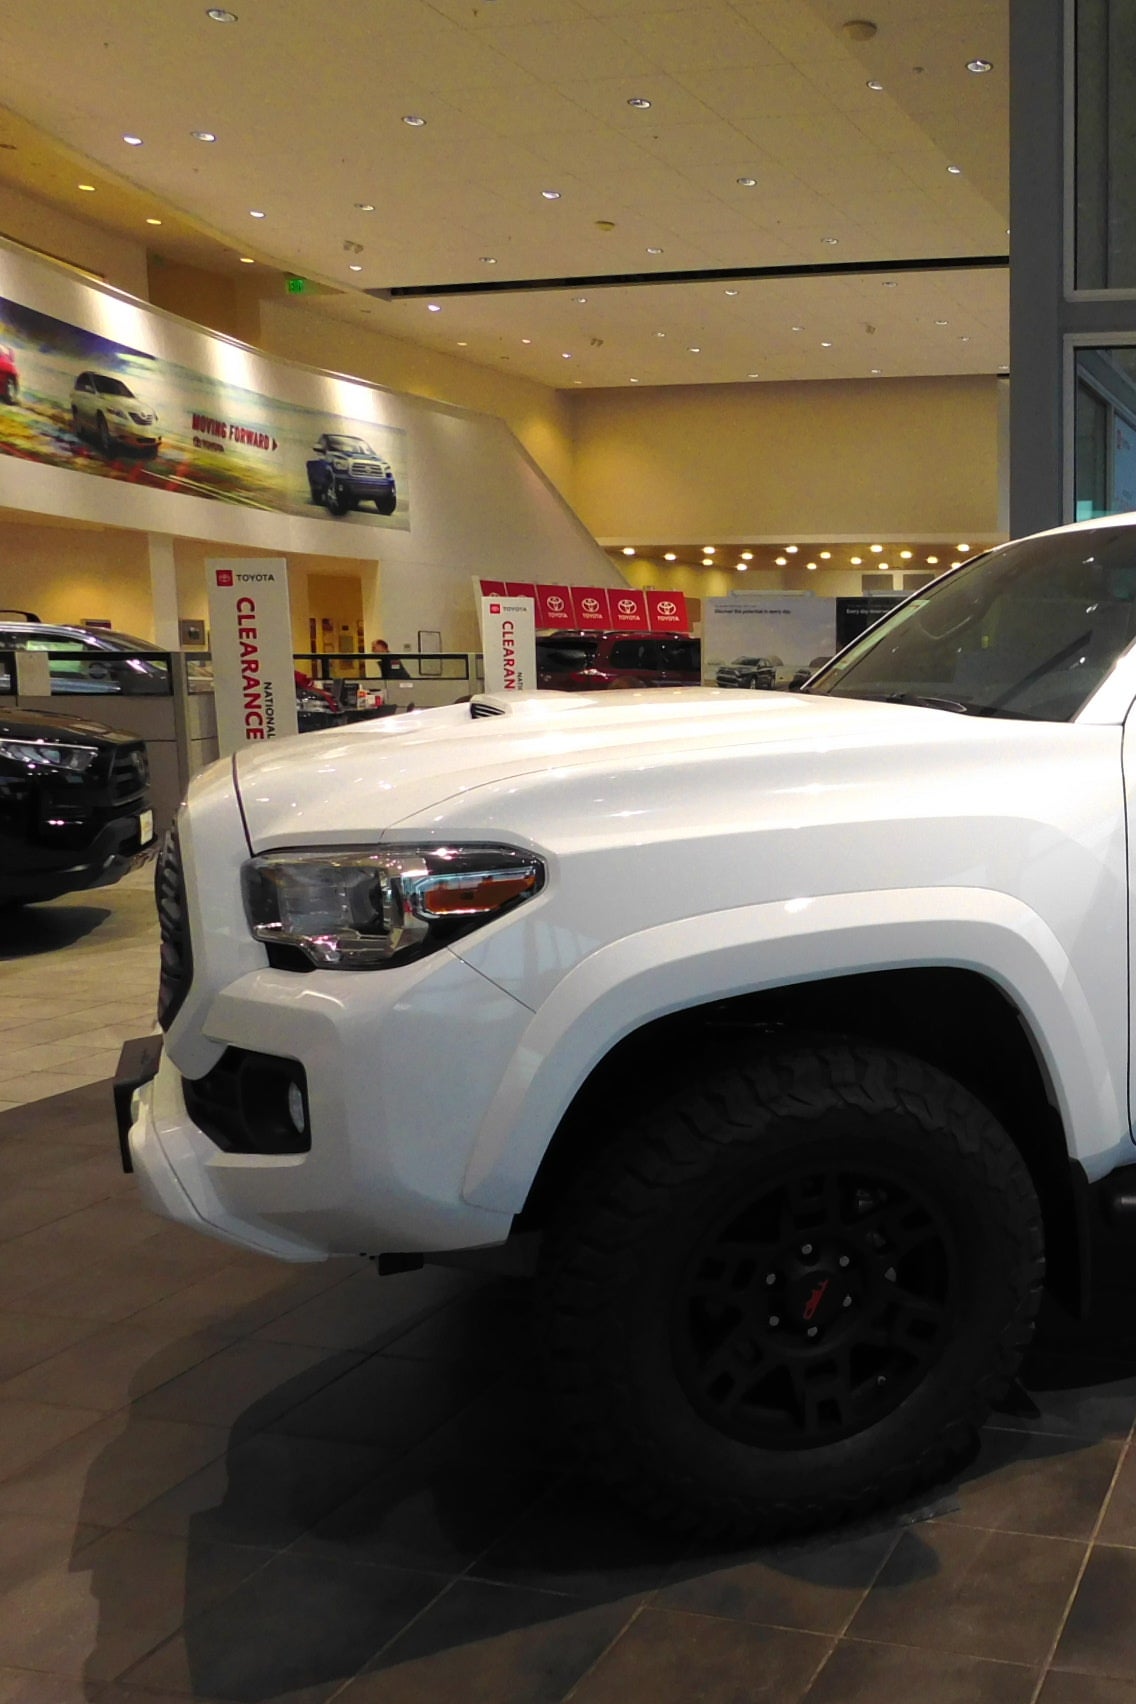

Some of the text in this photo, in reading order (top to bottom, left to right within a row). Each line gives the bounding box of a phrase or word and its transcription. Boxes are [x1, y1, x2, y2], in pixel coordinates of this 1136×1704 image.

[192, 413, 269, 450] MOVING FORWARD
[236, 574, 275, 582] TOYOTA
[236, 596, 265, 740] CLEARANCE
[502, 620, 516, 689] CLEARAN
[263, 681, 276, 739] NATIONAL
